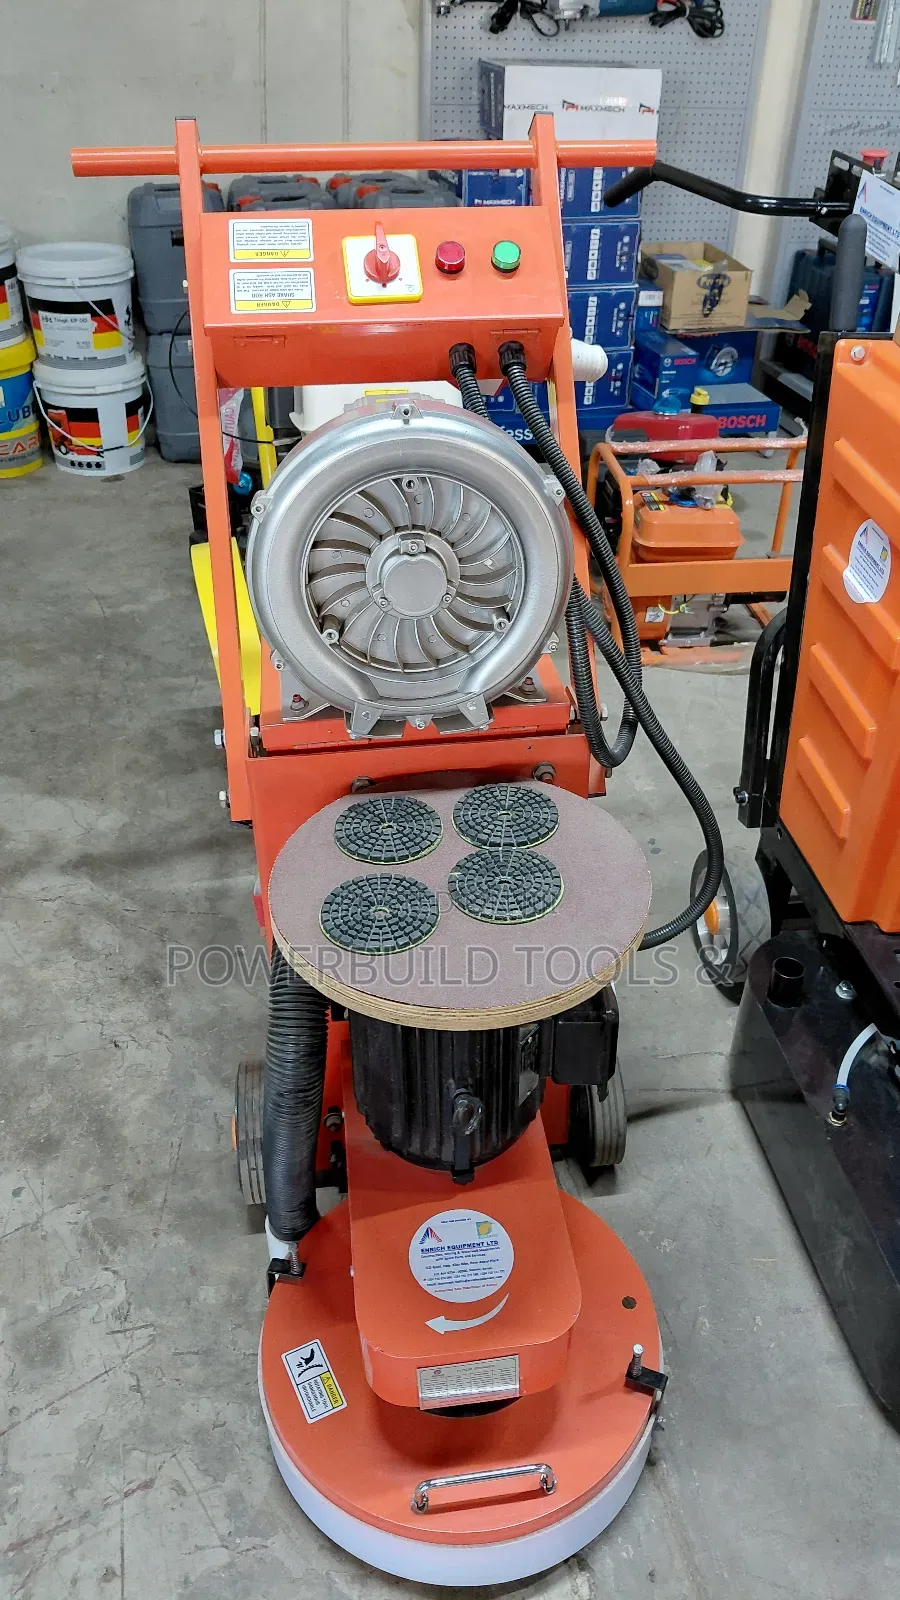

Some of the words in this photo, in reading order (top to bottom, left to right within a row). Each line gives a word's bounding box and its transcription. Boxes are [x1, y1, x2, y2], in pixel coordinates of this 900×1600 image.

[580, 105, 625, 113] MAXMECH
[674, 357, 697, 366] BOSCH
[717, 414, 767, 430] BOSCH
[421, 1245, 446, 1253] ENRICH
[447, 1242, 484, 1250] EQUIPMENT
[326, 1384, 339, 1405] DANGER
